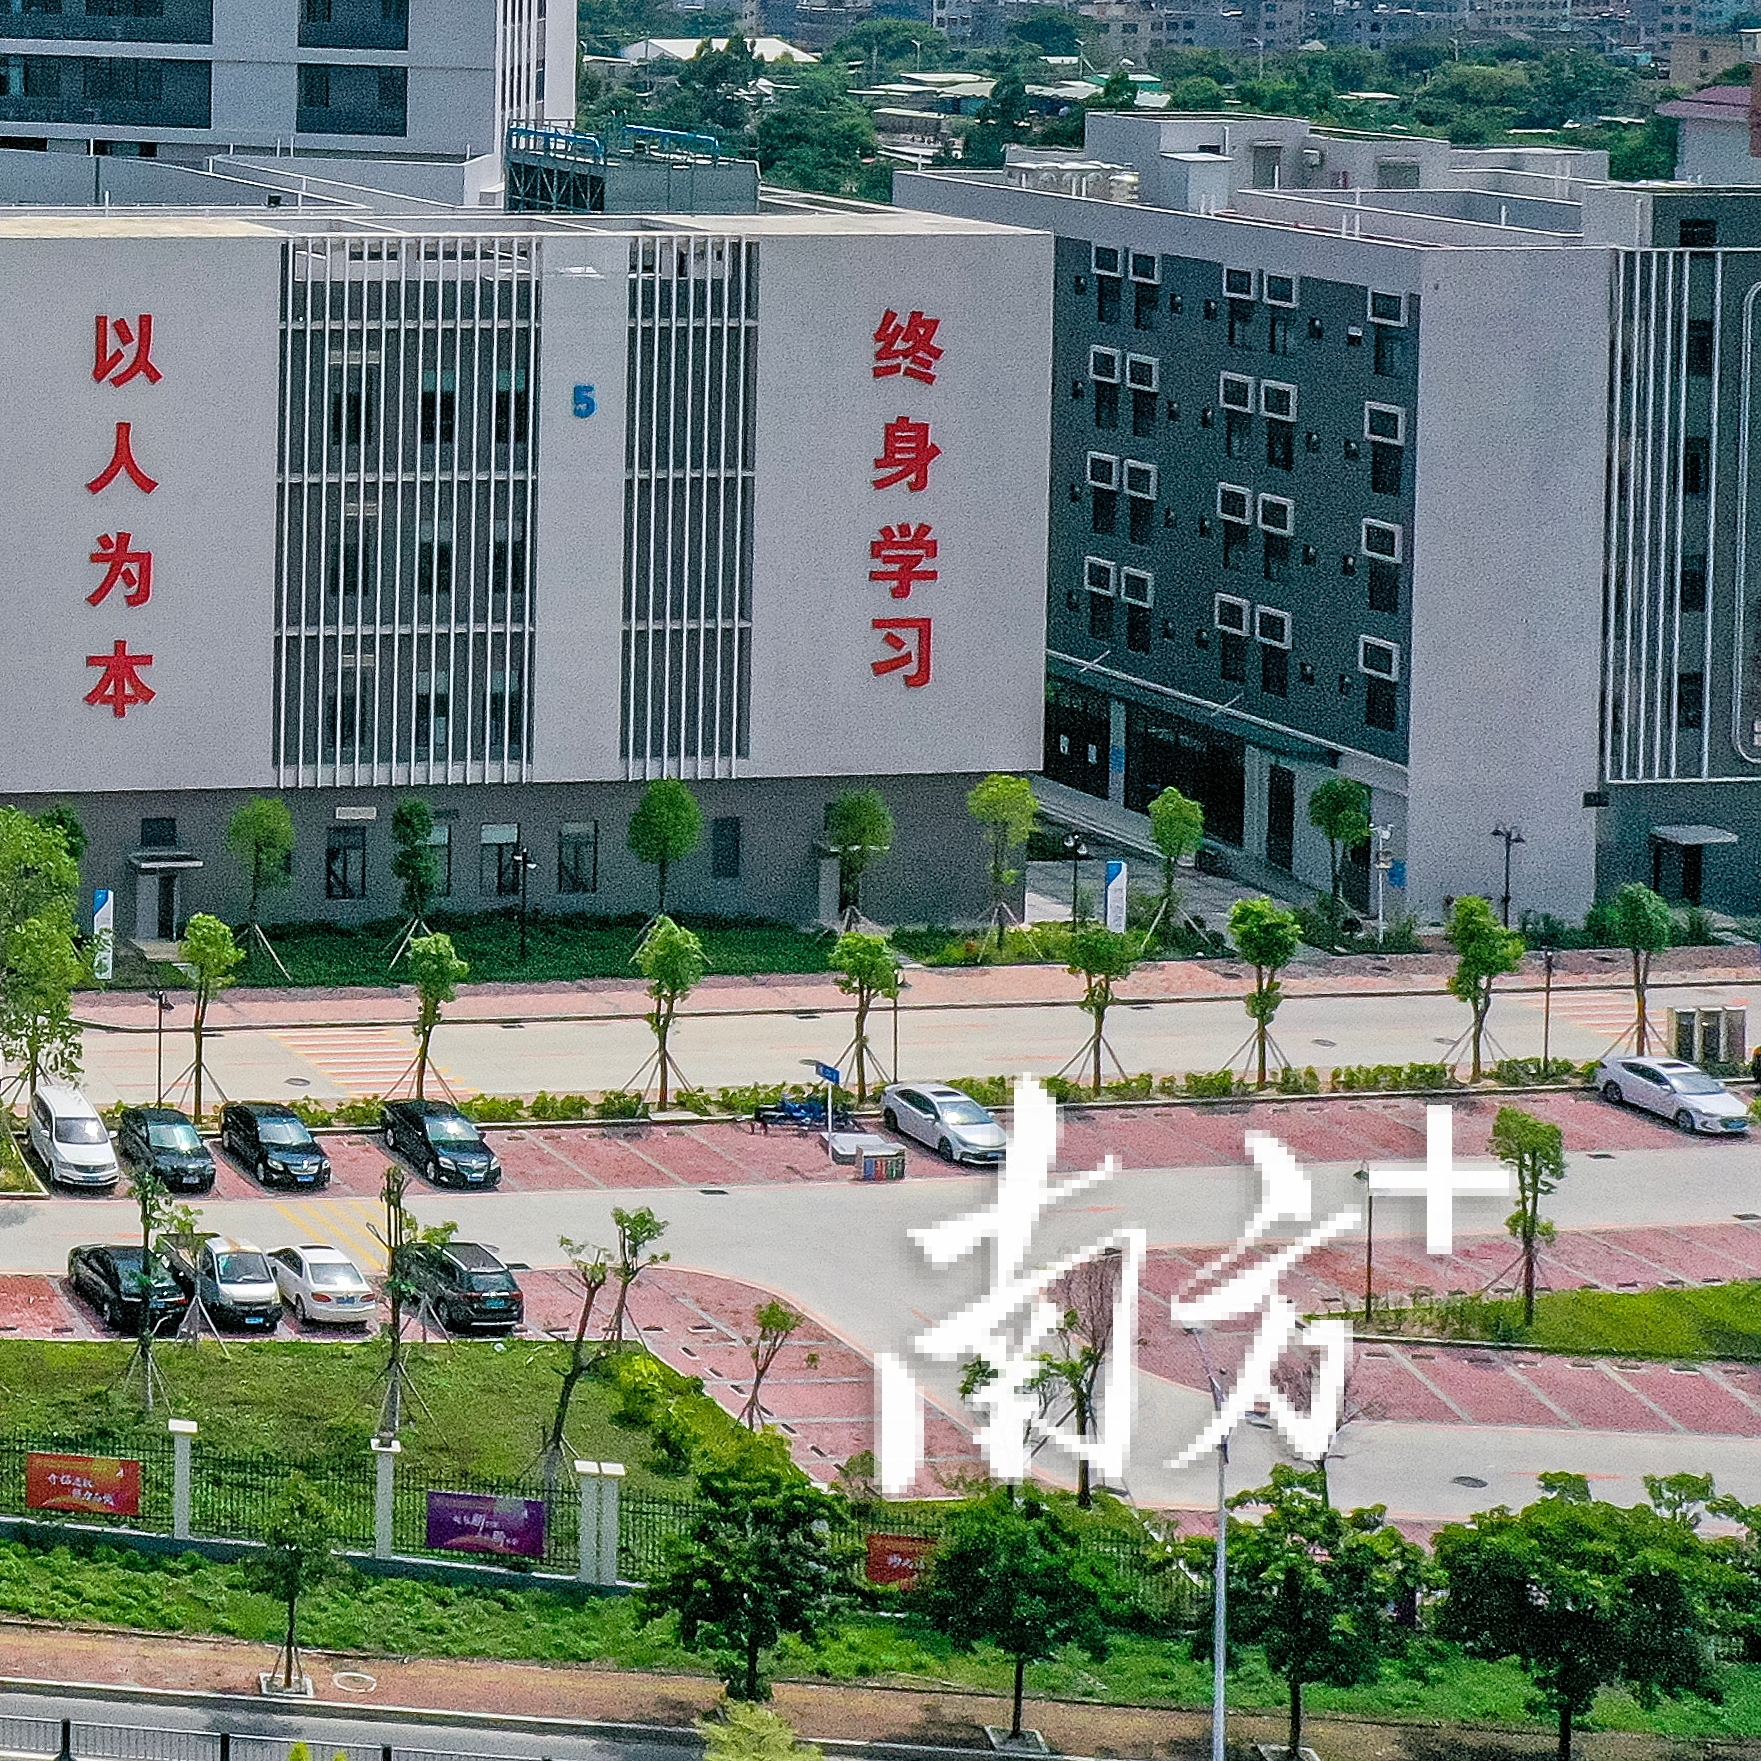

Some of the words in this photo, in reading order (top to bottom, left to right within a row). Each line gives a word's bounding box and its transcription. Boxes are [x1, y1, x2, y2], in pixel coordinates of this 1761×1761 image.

[83, 313, 163, 719] 以人为本
[572, 384, 598, 418] 5
[869, 309, 945, 689] 终身学习
